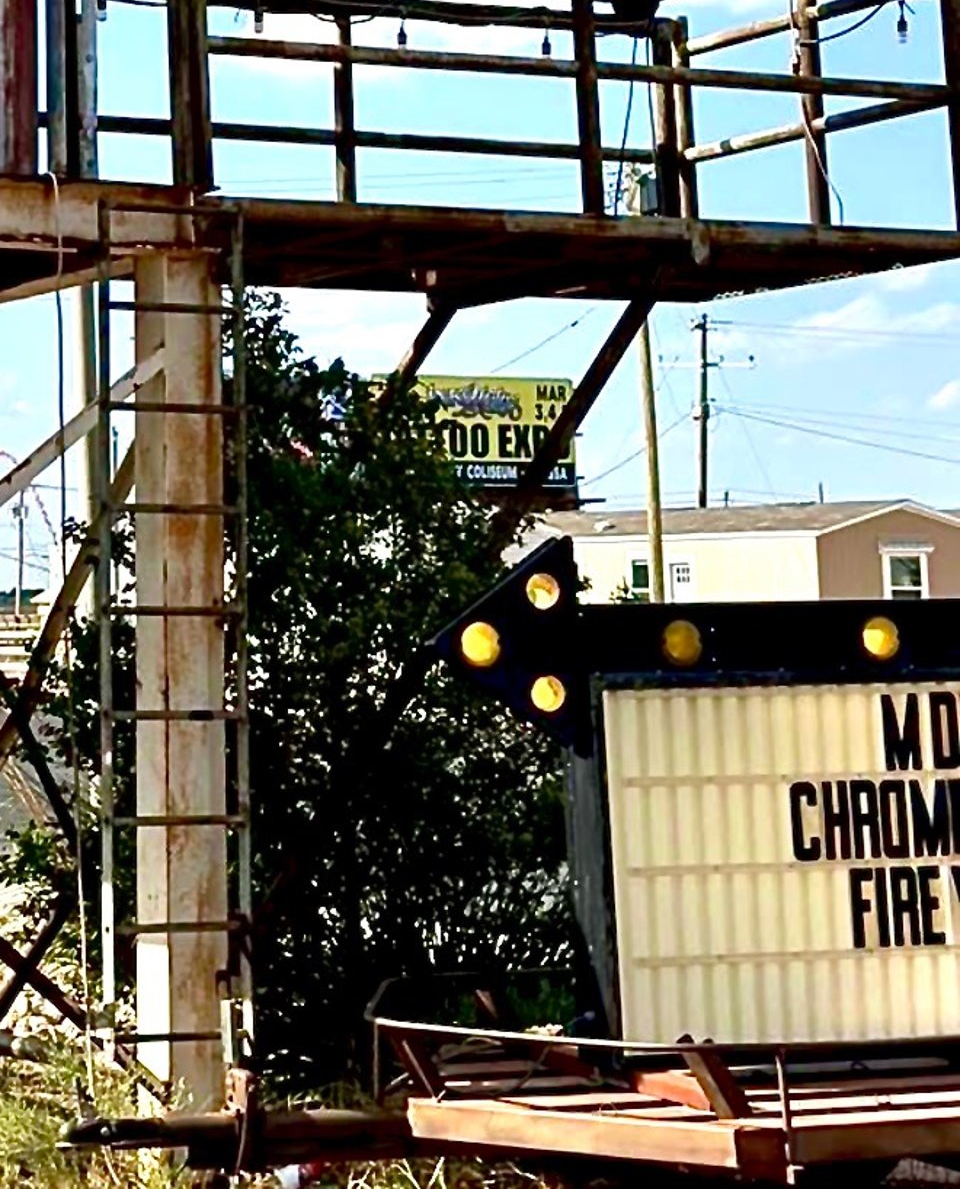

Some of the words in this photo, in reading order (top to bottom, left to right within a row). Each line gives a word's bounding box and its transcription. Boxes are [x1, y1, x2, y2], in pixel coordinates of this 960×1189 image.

[536, 384, 567, 401] MAR
[498, 424, 570, 460] EXP
[466, 464, 518, 480] COLISEUM
[849, 865, 960, 949] FIRE
